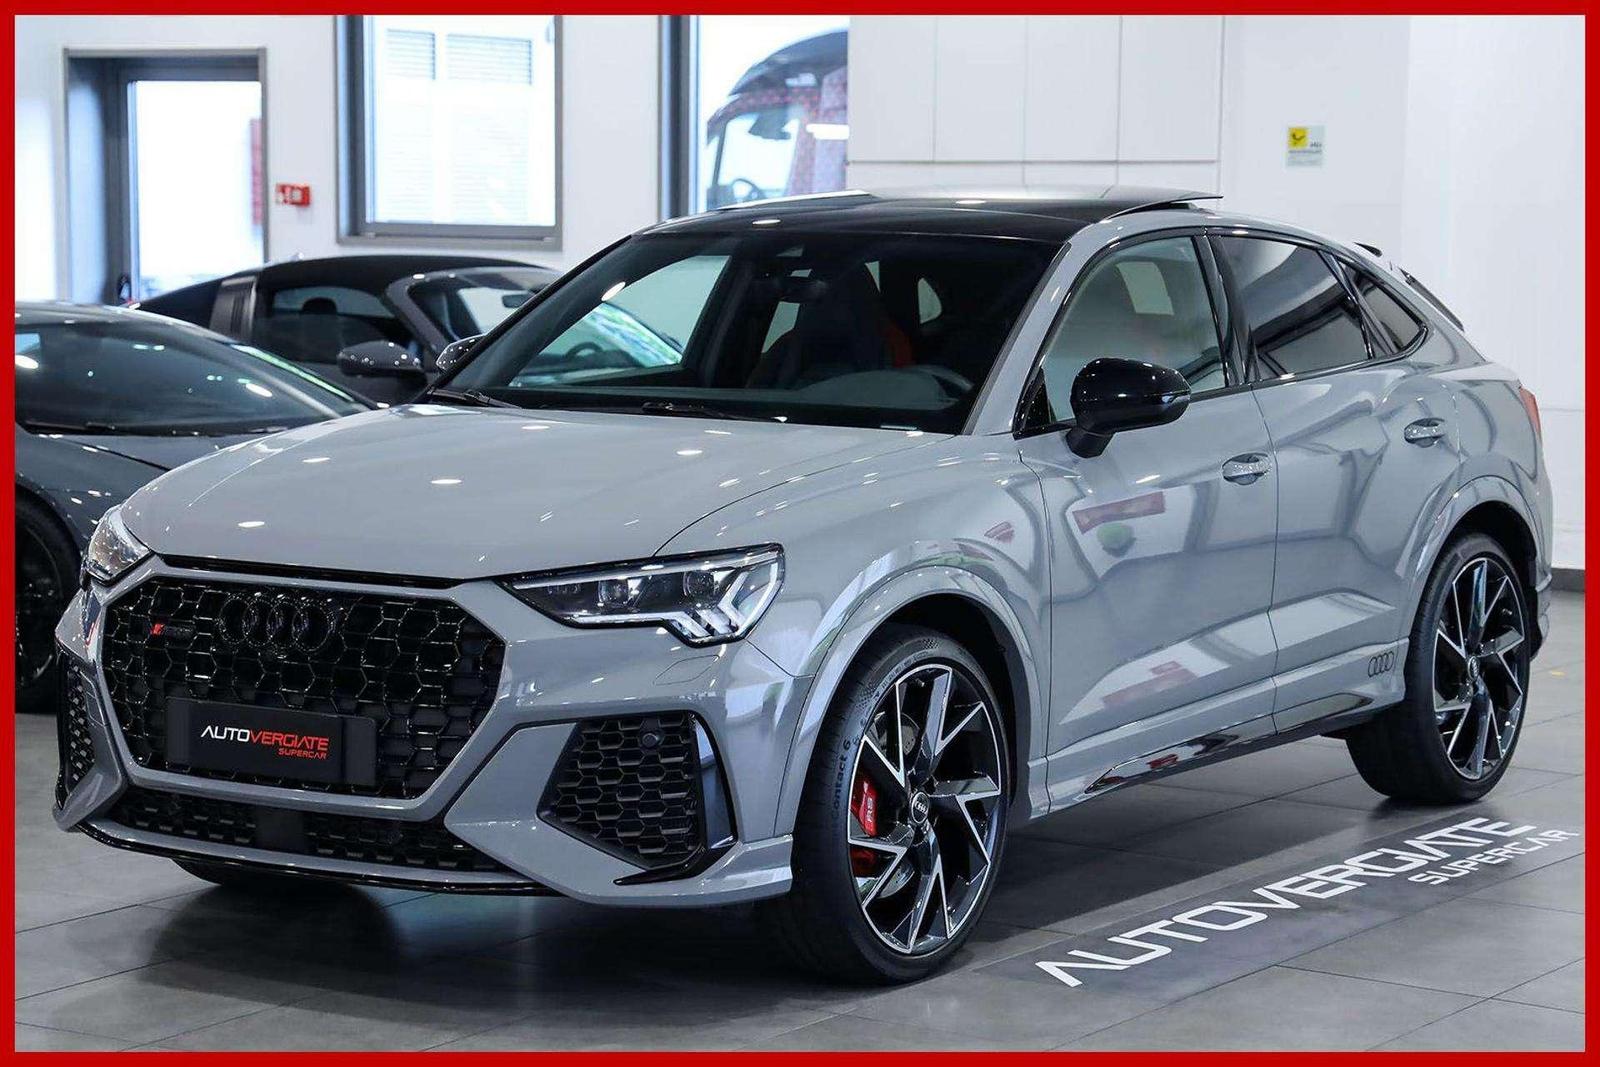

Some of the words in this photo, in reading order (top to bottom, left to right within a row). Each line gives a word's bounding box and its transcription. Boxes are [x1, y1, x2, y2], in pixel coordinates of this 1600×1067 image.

[201, 725, 329, 751] AUTOVERGIATE
[843, 739, 851, 751] 6
[278, 748, 327, 760] SUPERCAR
[1408, 829, 1579, 885] SUPERCAR
[1035, 817, 1536, 987] AUTOVERGIATE
